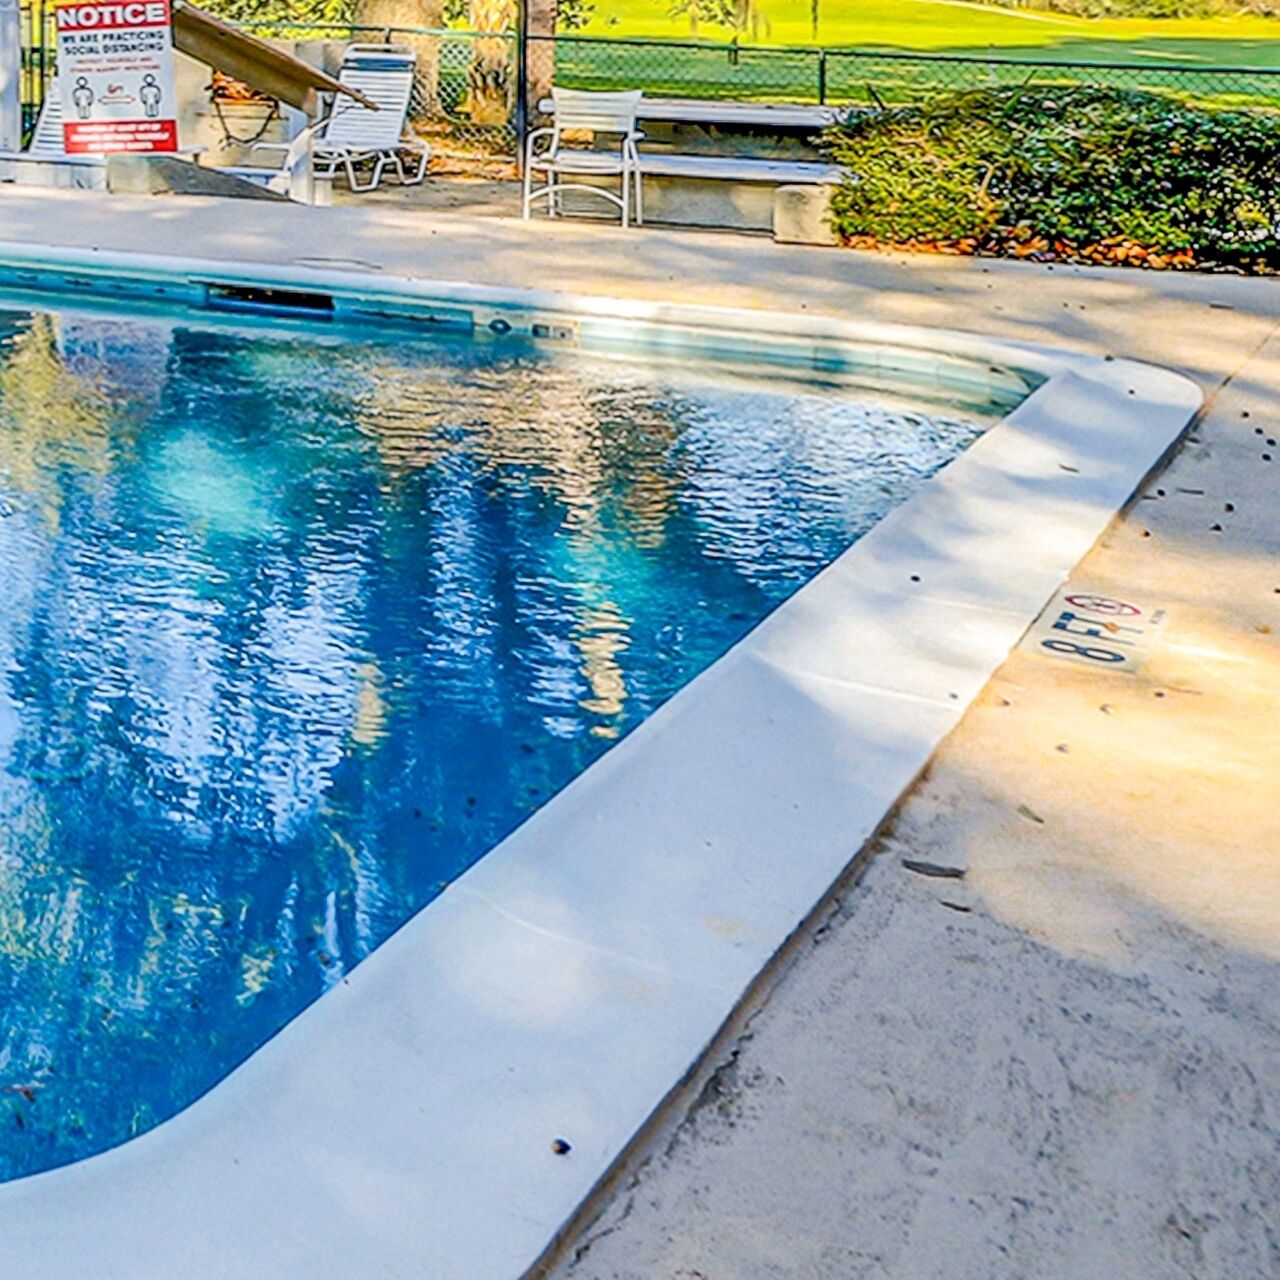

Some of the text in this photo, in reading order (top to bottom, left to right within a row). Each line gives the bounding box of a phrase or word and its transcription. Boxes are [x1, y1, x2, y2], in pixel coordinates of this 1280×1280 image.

[57, 3, 165, 28] NOTICE
[62, 30, 164, 43] WE ARE PRACTICING
[64, 41, 164, 55] SOCIAL DISTANCING
[1041, 640, 1125, 662] 8
